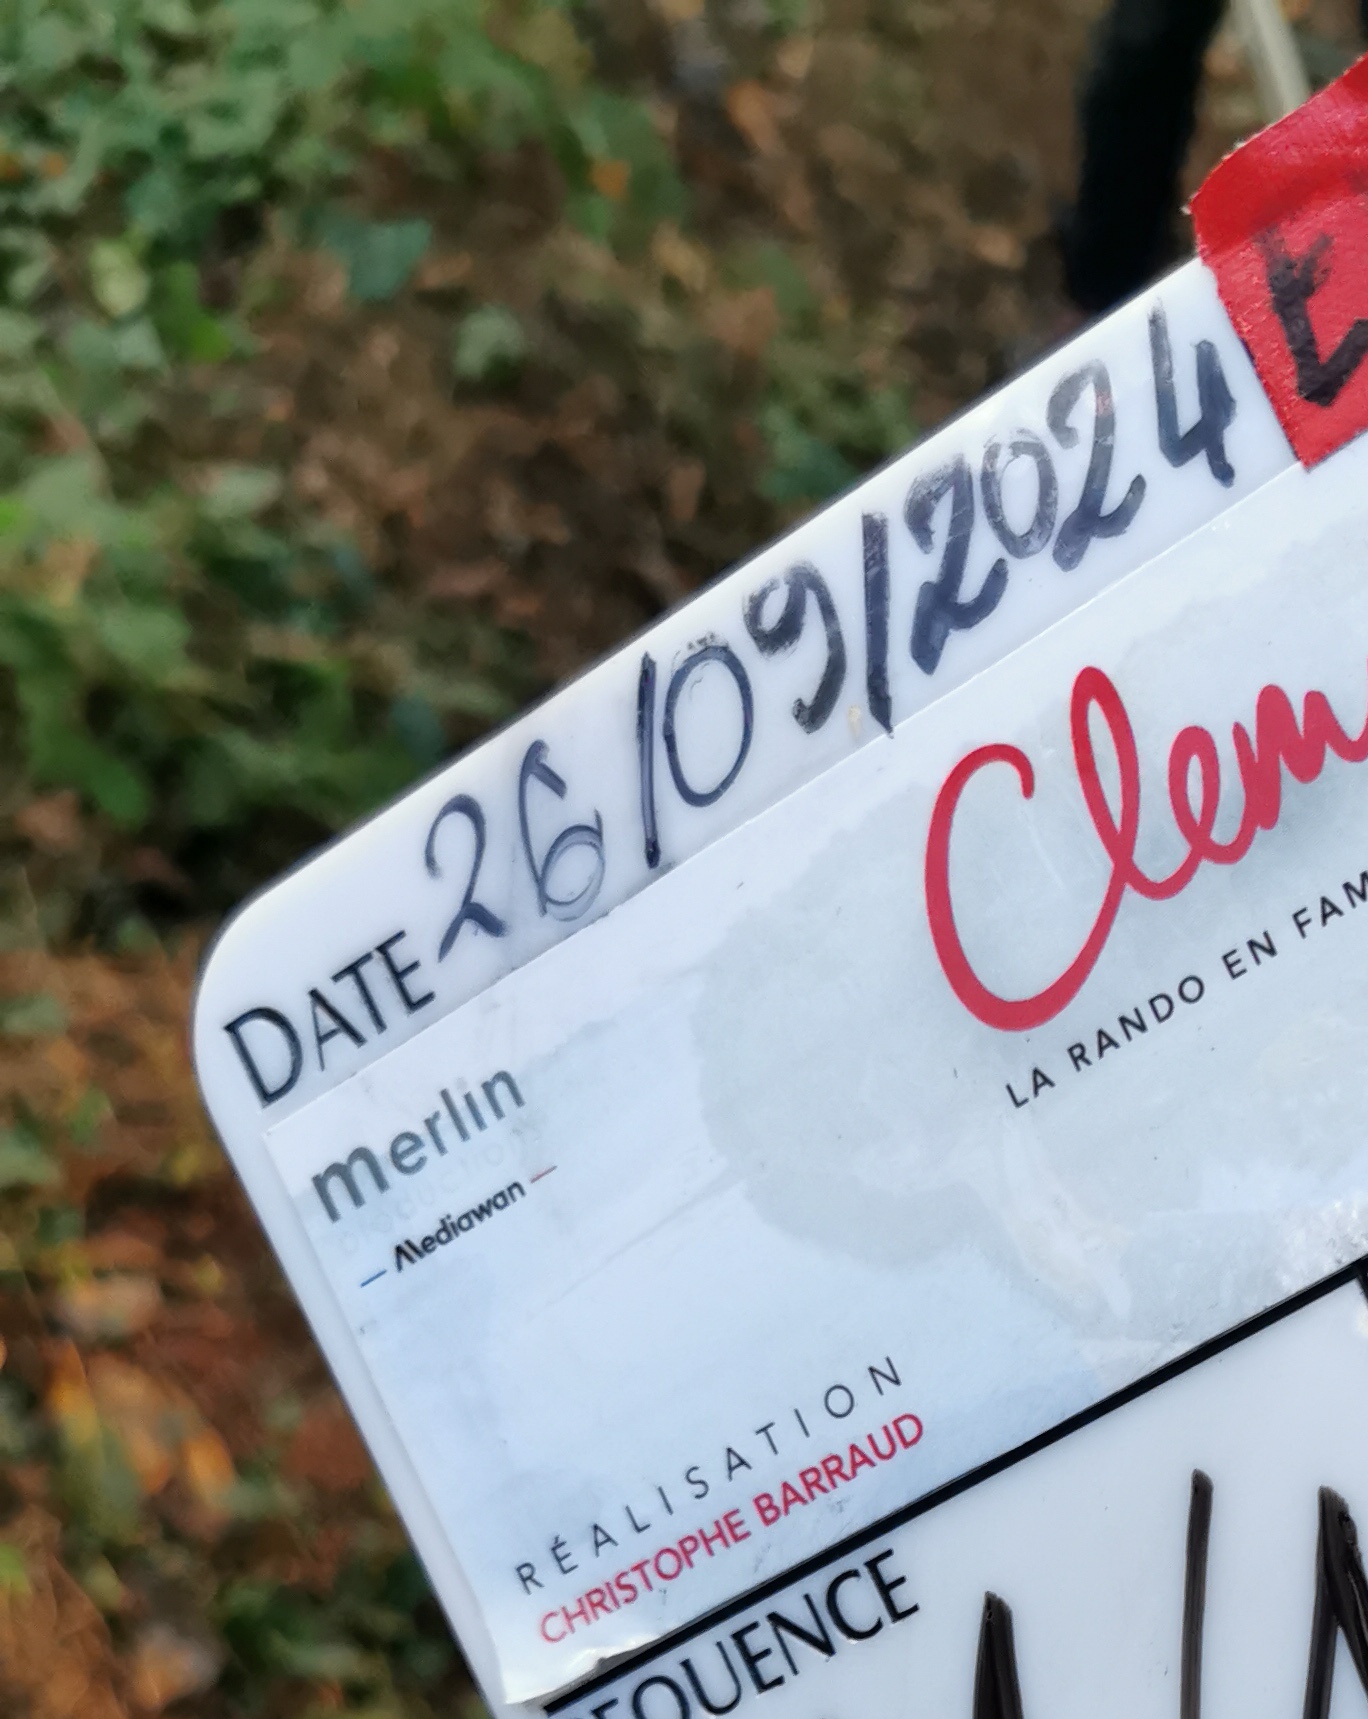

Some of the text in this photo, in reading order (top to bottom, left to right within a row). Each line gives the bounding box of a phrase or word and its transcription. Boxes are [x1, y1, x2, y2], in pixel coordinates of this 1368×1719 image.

[424, 296, 1237, 962] 26/09/2024
[222, 930, 436, 1110] DATE
[1006, 1066, 1056, 1109] LA
[1067, 973, 1206, 1072] RANDO
[1220, 929, 1279, 980] EN
[311, 1069, 527, 1224] merlin
[514, 1355, 903, 1596] RÉALISATION
[539, 1411, 925, 1645] CHRISTOPHE BARRAUD
